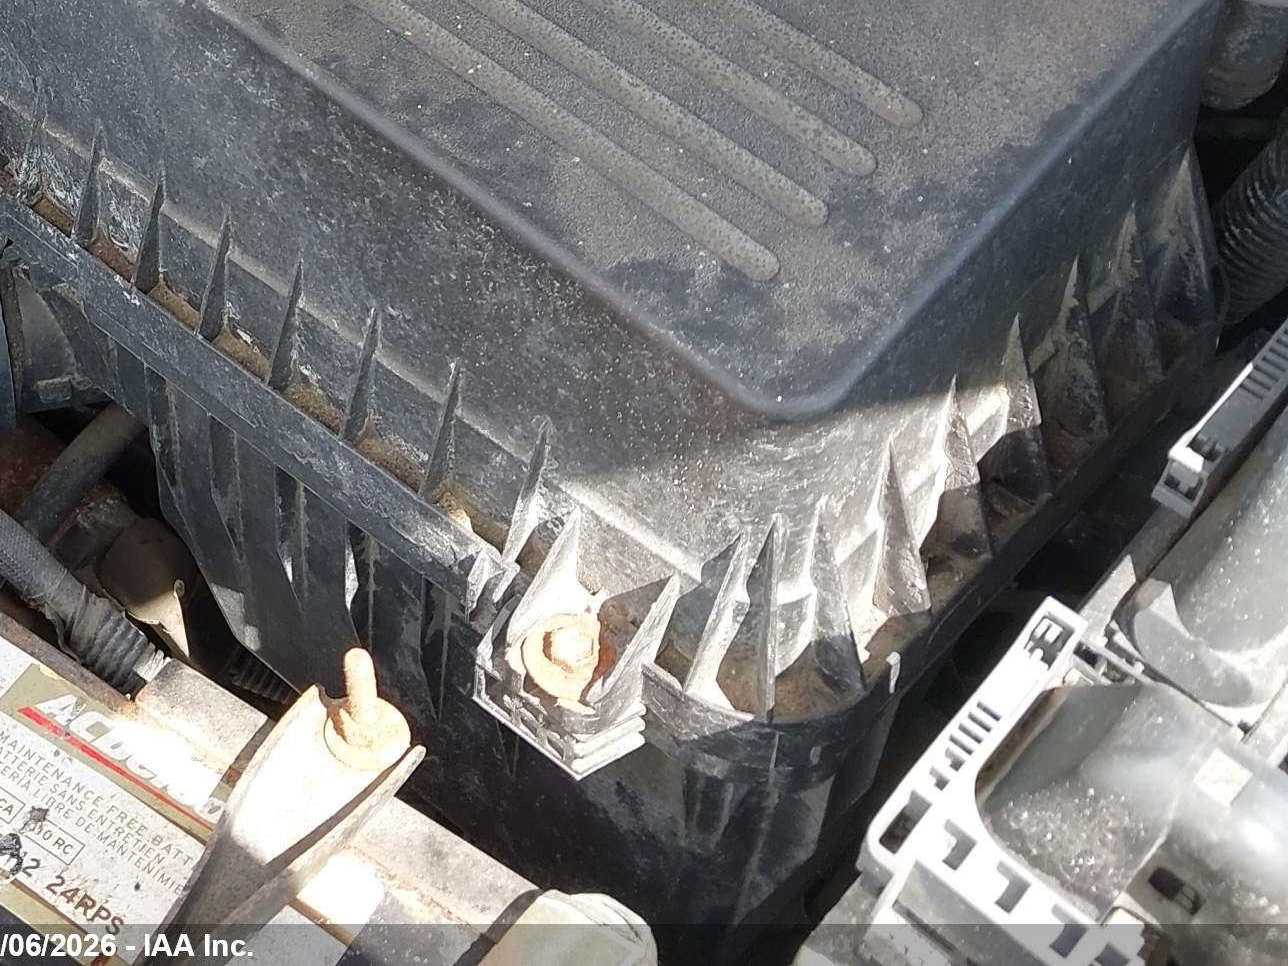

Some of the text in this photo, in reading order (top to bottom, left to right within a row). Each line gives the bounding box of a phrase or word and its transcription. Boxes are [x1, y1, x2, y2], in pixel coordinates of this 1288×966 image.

[31, 787, 75, 819] LIBRE
[73, 815, 95, 834] DE
[48, 782, 88, 812] SANS
[86, 808, 166, 865] ENTRETIEN
[104, 802, 150, 837] FREE
[50, 835, 74, 855] RC
[44, 872, 129, 938] 24RPS
